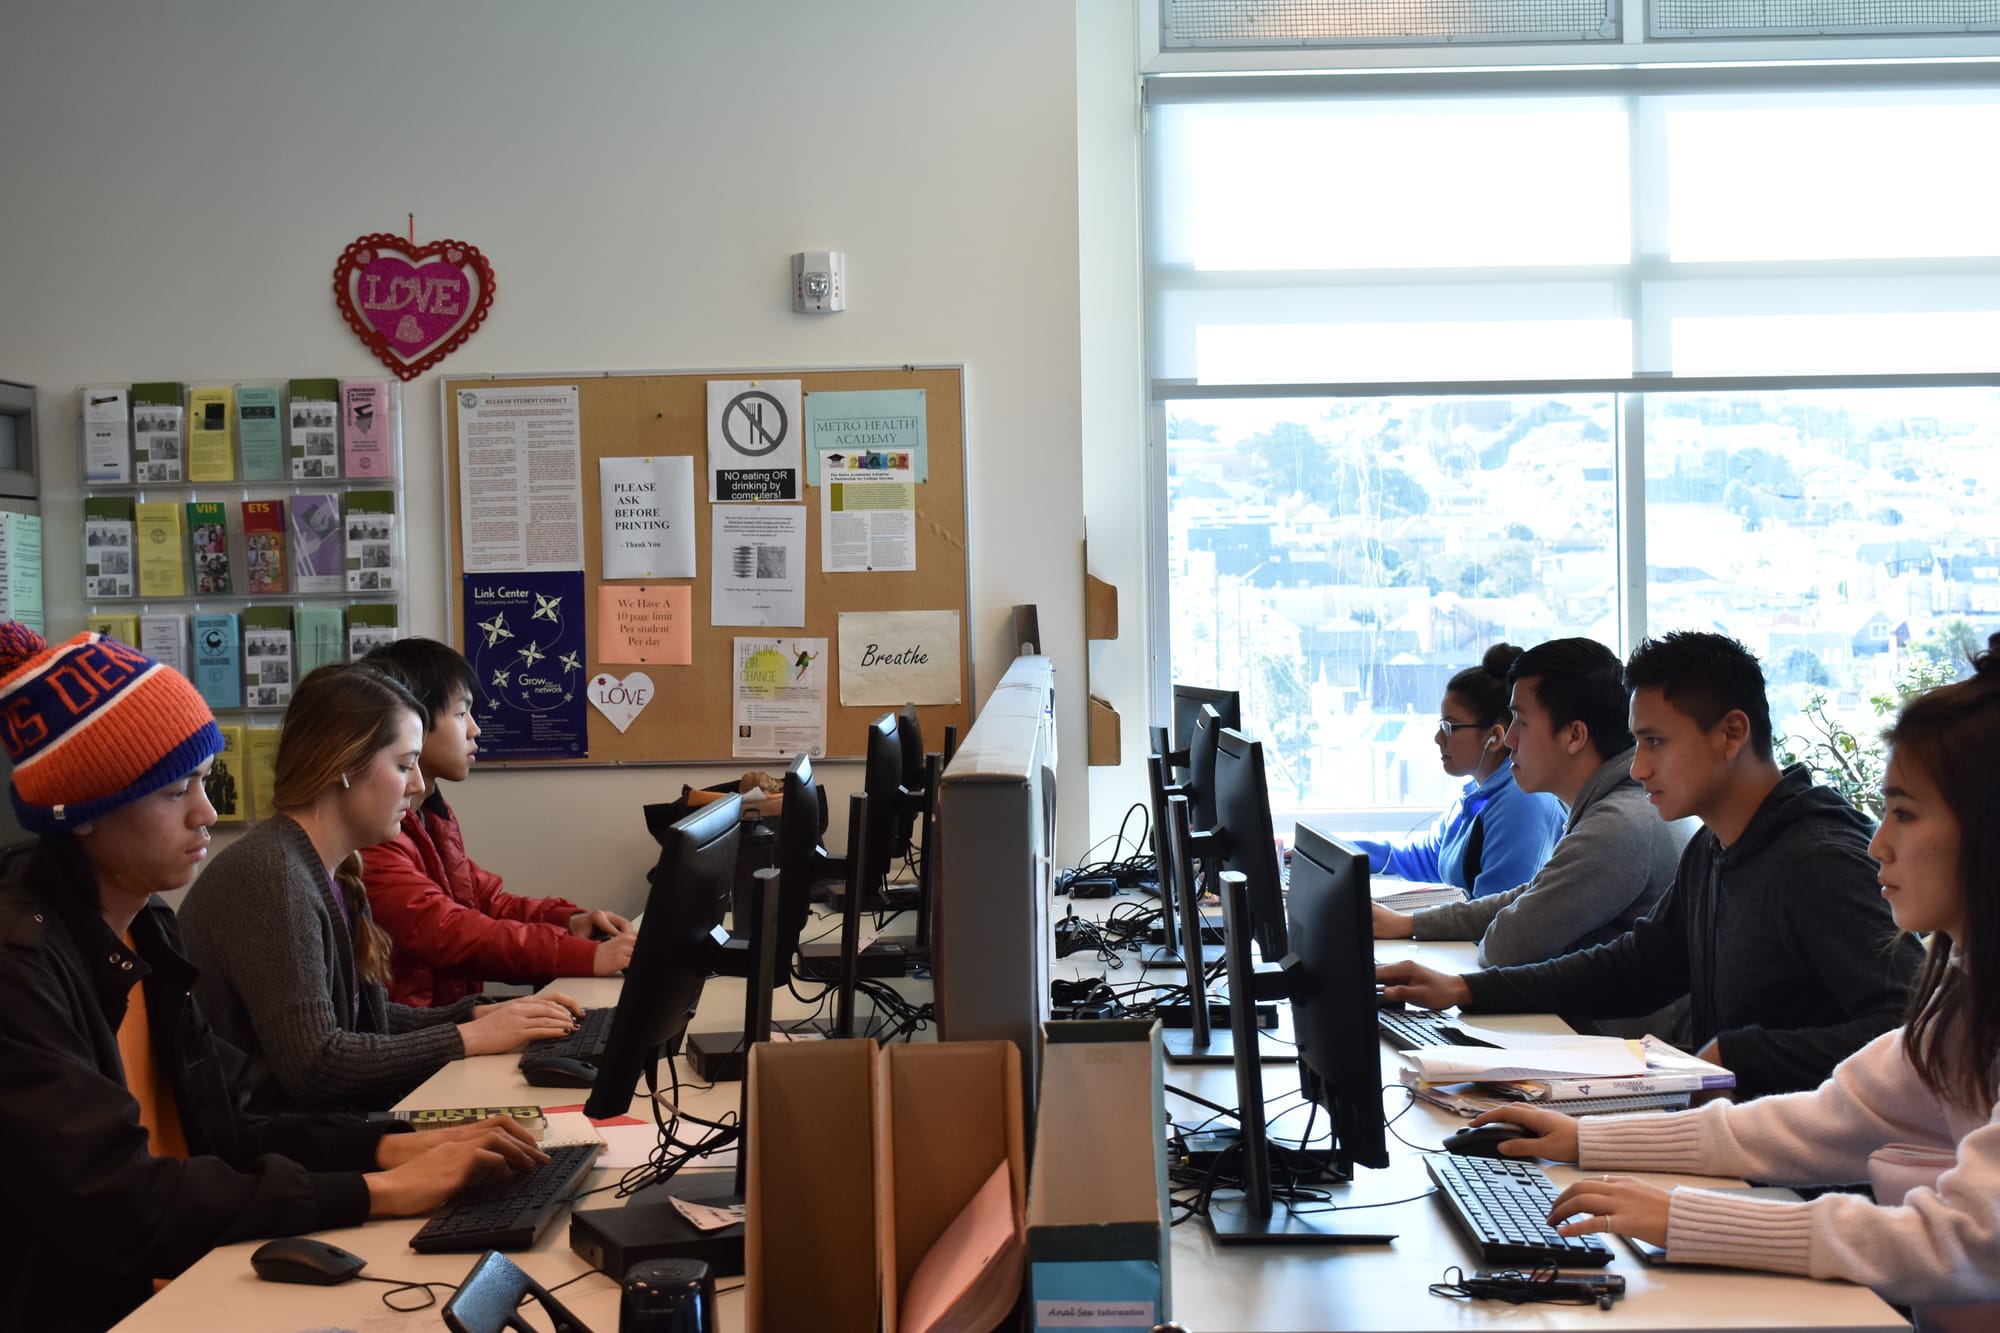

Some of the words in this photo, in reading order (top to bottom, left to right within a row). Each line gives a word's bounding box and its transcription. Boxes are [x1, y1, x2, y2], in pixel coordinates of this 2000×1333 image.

[364, 274, 461, 315] LOVE
[816, 420, 861, 433] METRO
[865, 419, 915, 431] HEALTH
[835, 433, 897, 445] ACADEMY
[724, 471, 740, 481] NO
[742, 472, 770, 482] eating
[772, 471, 788, 480] OR
[614, 482, 657, 493] PLEASE
[731, 481, 767, 492] drinking
[769, 481, 780, 491] by
[617, 496, 640, 505] ASK
[731, 491, 781, 500] computers!
[196, 503, 218, 514] VIH
[248, 503, 271, 513] ETS
[615, 508, 660, 518] BEFORE
[615, 520, 670, 531] PRINTING
[474, 586, 495, 599] Link
[497, 586, 530, 598] Center
[618, 599, 635, 608] We
[637, 599, 660, 608] Have
[663, 599, 671, 608] A
[617, 611, 628, 621] 10
[630, 614, 650, 623] page
[652, 611, 673, 621] limit
[620, 624, 635, 633] Per
[637, 624, 669, 633] student
[628, 636, 643, 646] Per
[644, 636, 661, 647] day
[740, 643, 779, 656] HEALING
[860, 643, 929, 667] Breathe
[740, 656, 759, 669] FOR
[518, 673, 546, 686] Grow
[740, 670, 777, 682] CHANGE
[534, 684, 563, 694] network
[600, 687, 648, 706] LOVE
